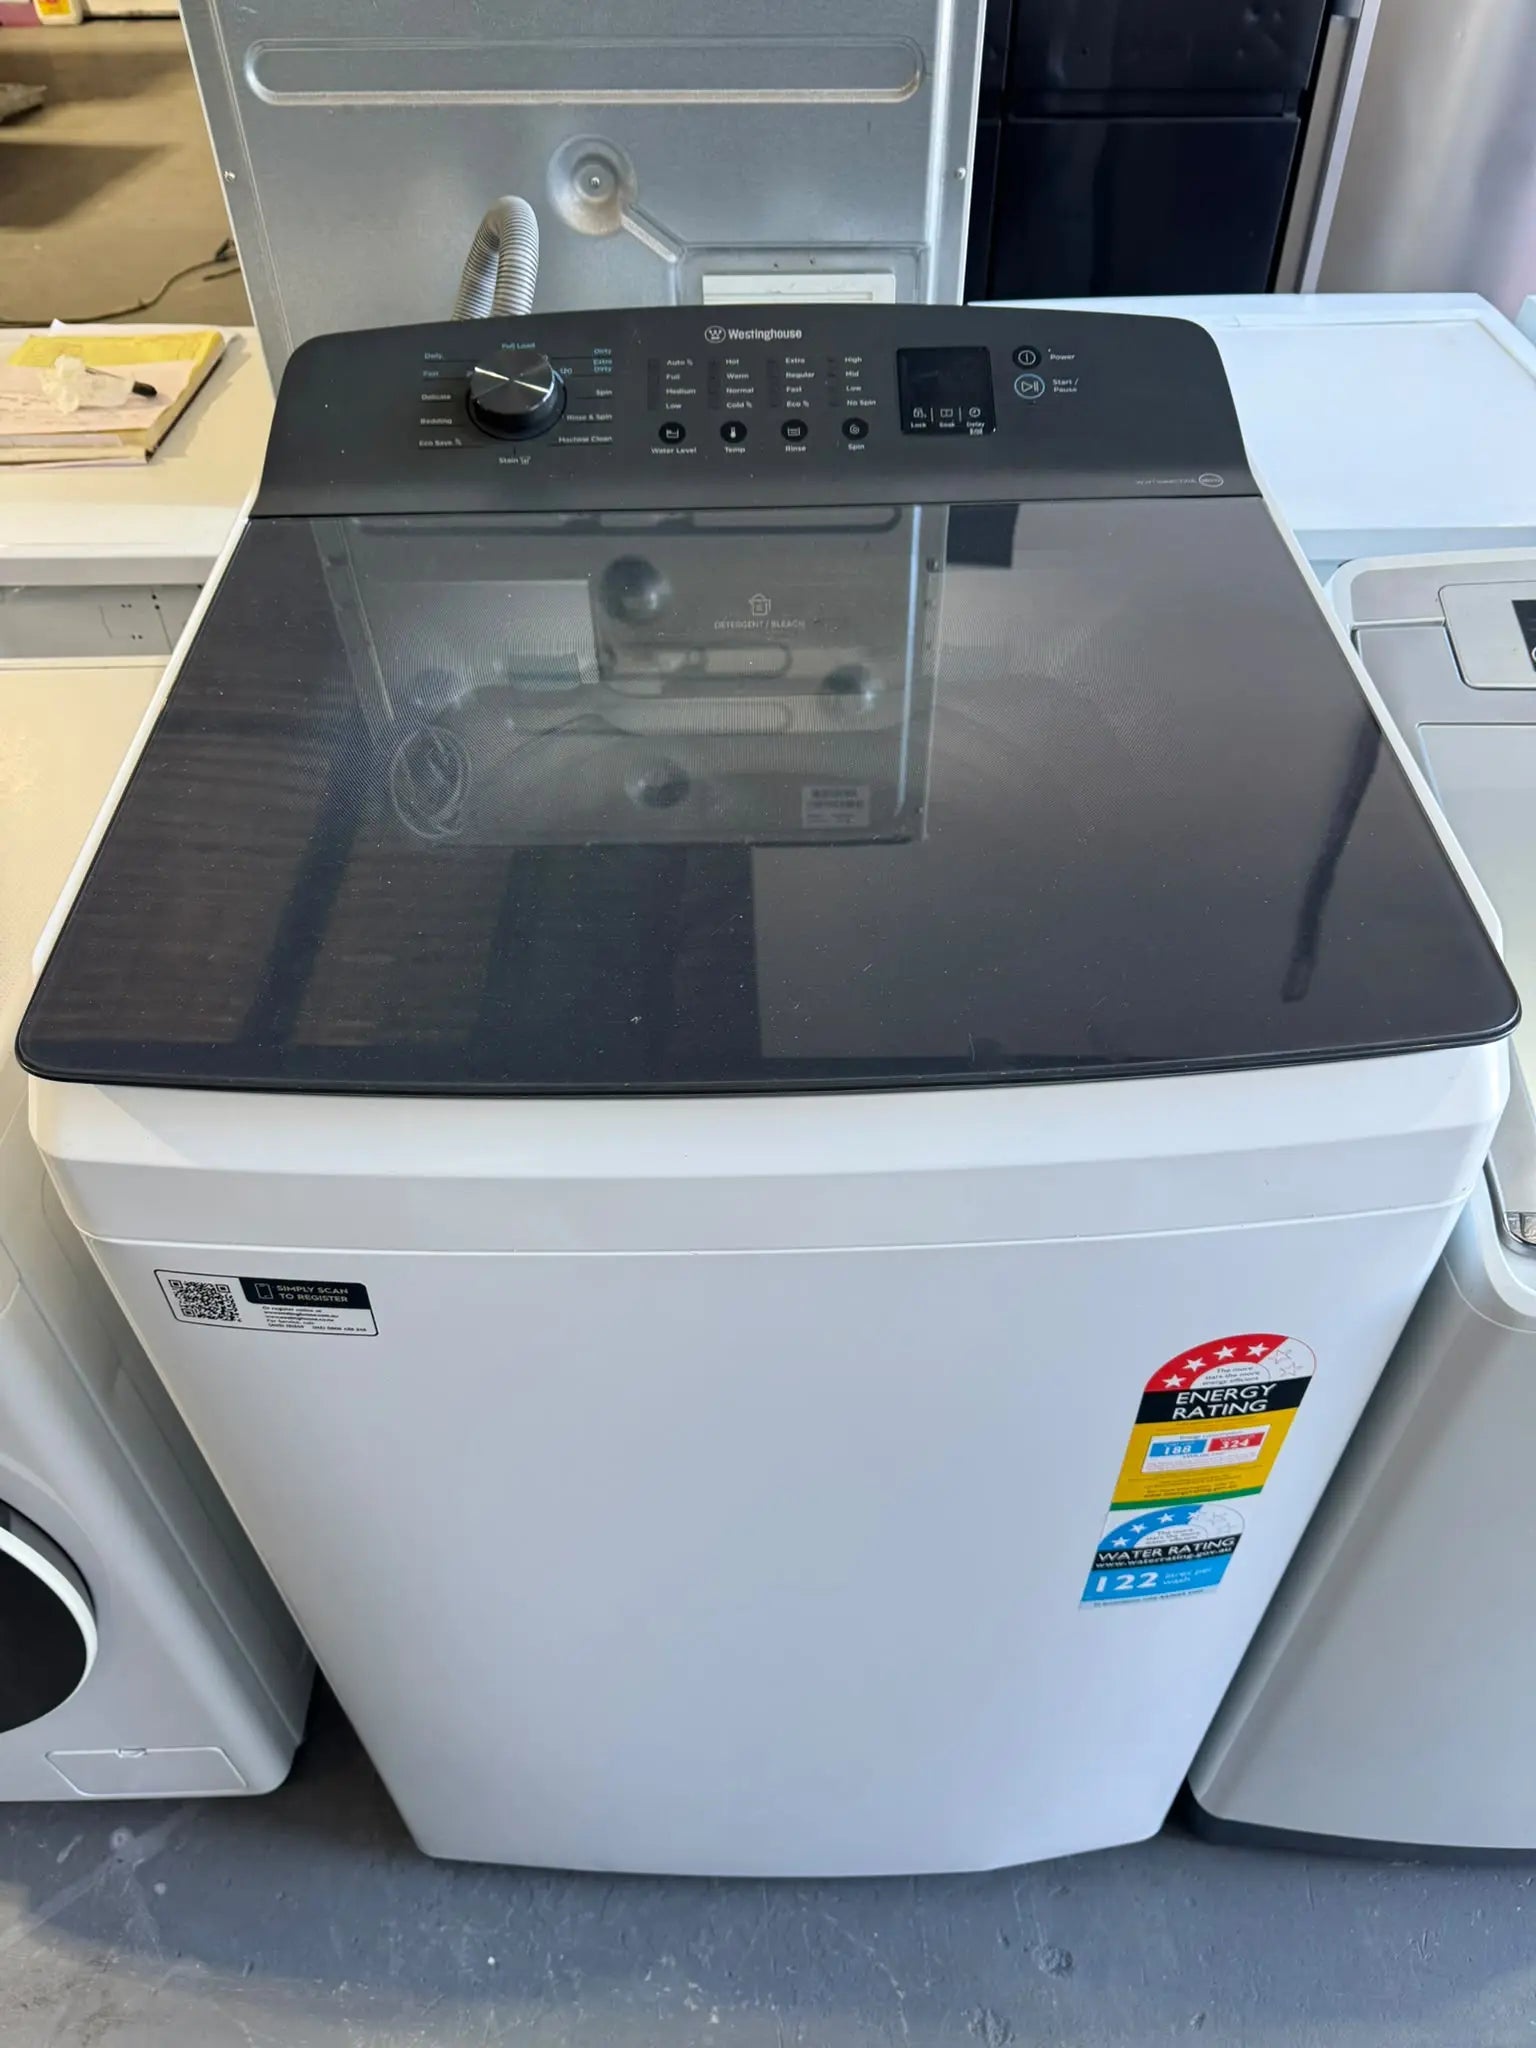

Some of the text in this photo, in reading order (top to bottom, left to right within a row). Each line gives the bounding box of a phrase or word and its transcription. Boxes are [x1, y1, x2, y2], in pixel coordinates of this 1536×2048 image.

[728, 328, 802, 342] Westinghouse
[517, 342, 536, 350] Load
[785, 357, 806, 365] Extra
[844, 355, 863, 364] High
[1050, 353, 1076, 361] Power
[666, 359, 686, 367] Auto
[725, 358, 740, 366] Hot
[666, 373, 681, 381] Full
[726, 372, 750, 380] Warm
[785, 371, 815, 379] Regular
[845, 370, 860, 378] Mid
[1052, 378, 1073, 386] Start
[596, 389, 613, 397] Spin
[665, 387, 697, 395] Medium
[726, 386, 755, 394] Normal
[786, 385, 803, 393] Fast
[421, 393, 452, 401] Delicate
[665, 402, 683, 410] Low
[726, 401, 745, 409] Cold
[786, 400, 801, 408] Eco
[846, 399, 877, 407] No Spin
[596, 413, 613, 421] Spin
[420, 418, 453, 426] Bedding
[910, 421, 928, 429] Lock
[939, 420, 956, 428] Soak
[558, 435, 613, 444] Machine Clean
[650, 445, 698, 454] Water Level
[724, 445, 747, 454] Temp
[785, 444, 808, 452] Rinse
[848, 442, 865, 451] Spin
[499, 457, 519, 465] Stain
[276, 1285, 315, 1294] SIMPLY
[297, 1294, 349, 1303] REGISTER
[1175, 1383, 1278, 1406] ENERGY
[1172, 1399, 1269, 1420] RATING
[1220, 1438, 1250, 1449] 324
[1164, 1445, 1192, 1455] 188
[1099, 1537, 1236, 1562] WATER RATING
[1096, 1546, 1232, 1568] www.waterrating.gov.au
[1096, 1572, 1159, 1593] 122
